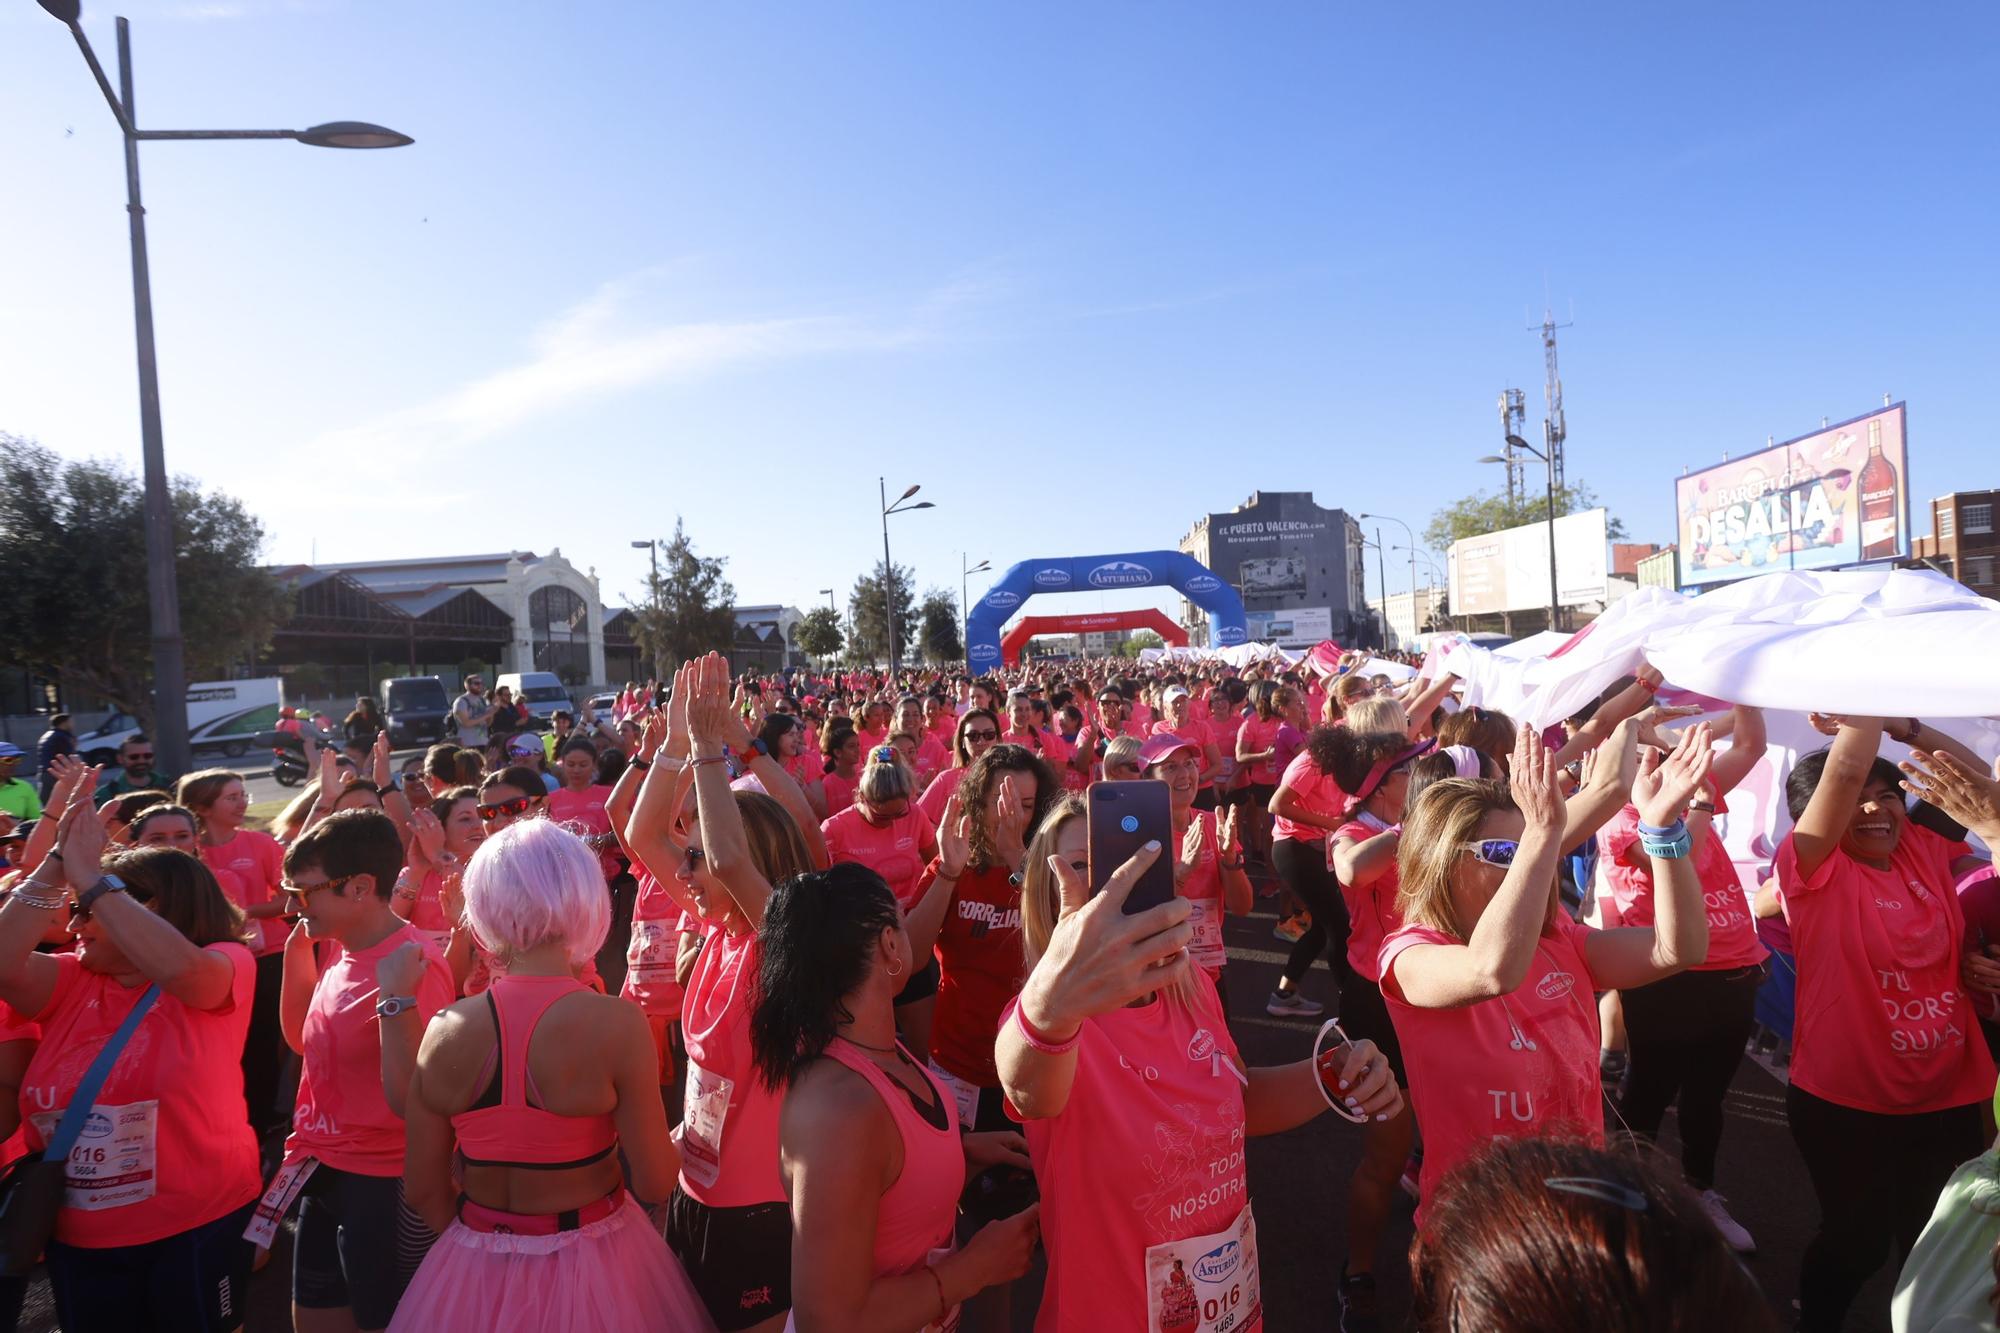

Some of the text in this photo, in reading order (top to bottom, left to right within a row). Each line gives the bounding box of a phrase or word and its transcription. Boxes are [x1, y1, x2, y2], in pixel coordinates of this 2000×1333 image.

[1689, 485, 1833, 550] DESALIA
[1219, 527, 1228, 535] EL
[1230, 522, 1263, 534] PUERTO
[1228, 535, 1276, 543] Restaurante
[1094, 572, 1148, 583] ASTURIANA
[1088, 617, 1118, 625] Santander
[186, 690, 233, 700] erprise
[958, 900, 1022, 930] CORRELIA
[1192, 926, 1205, 937] 16
[1878, 970, 1910, 992] TU
[1488, 1089, 1534, 1122] TU
[72, 1145, 106, 1163] 016
[1209, 1151, 1245, 1179] TODA
[100, 1187, 144, 1201] Santander
[1170, 1178, 1247, 1222] NOSOTRA
[1203, 1283, 1240, 1321] 016
[1214, 1313, 1234, 1333] 1469
